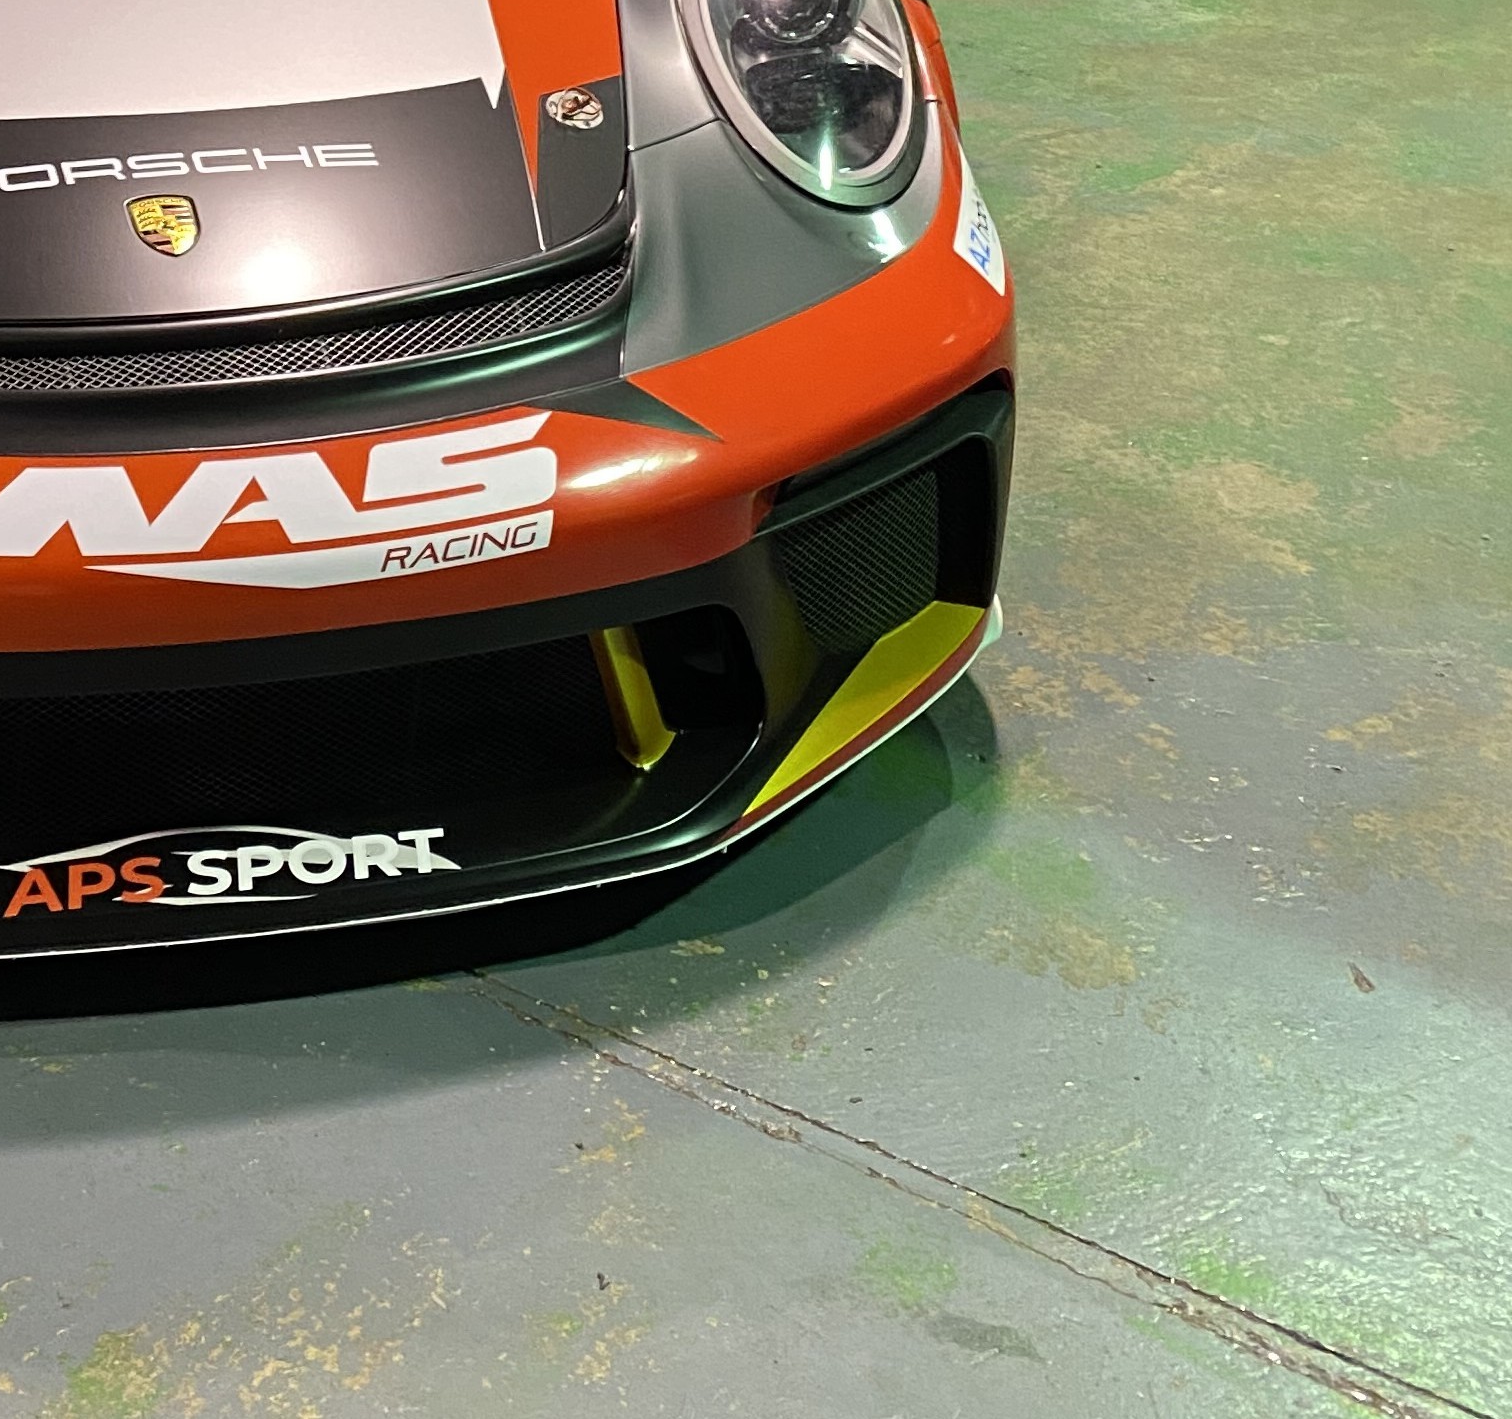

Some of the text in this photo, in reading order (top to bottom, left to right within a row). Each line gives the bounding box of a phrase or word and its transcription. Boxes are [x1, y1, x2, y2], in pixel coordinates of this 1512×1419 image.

[380, 521, 540, 573] RACING
[3, 828, 445, 919] APS SPORT
